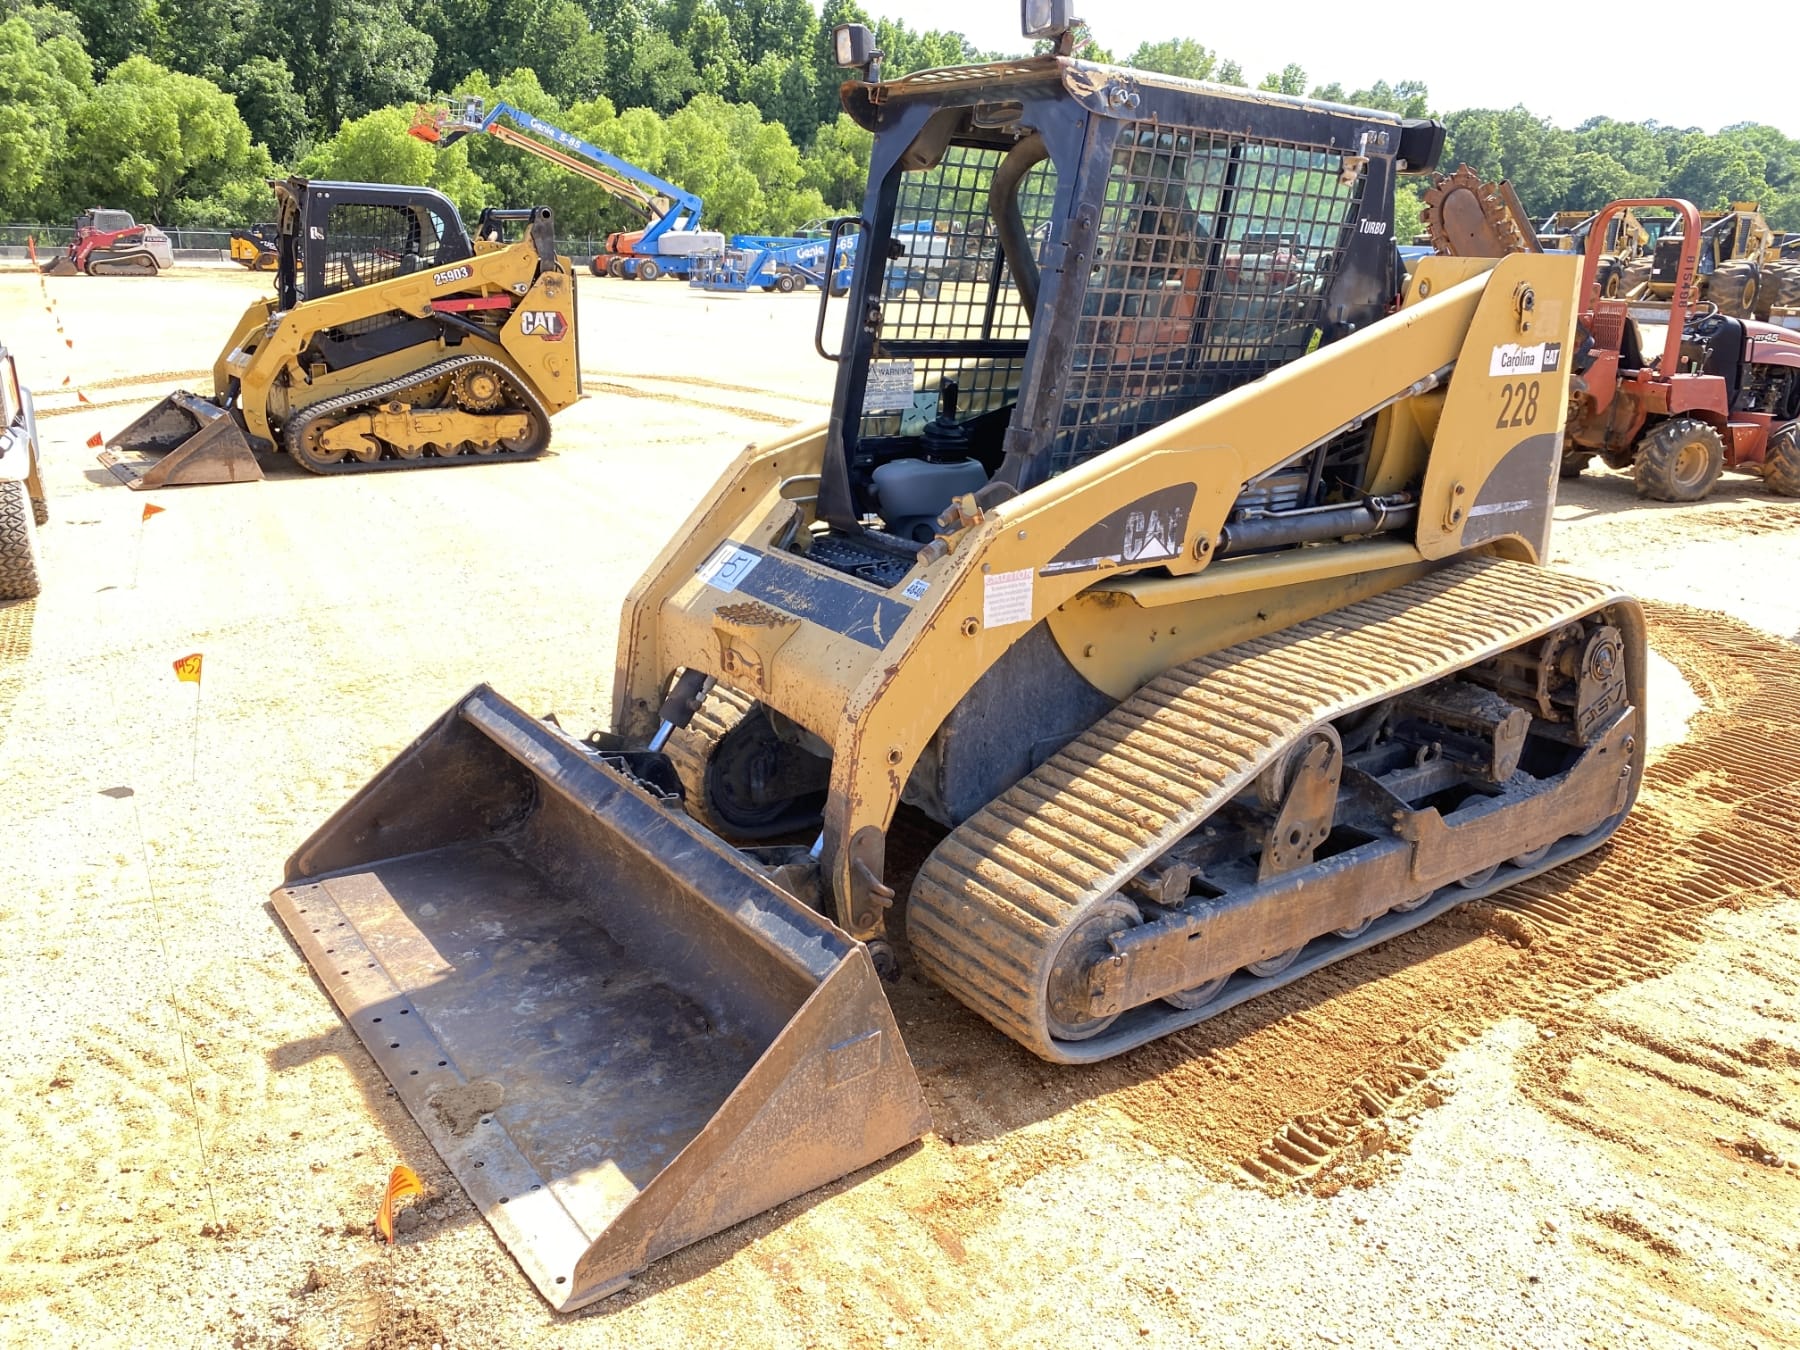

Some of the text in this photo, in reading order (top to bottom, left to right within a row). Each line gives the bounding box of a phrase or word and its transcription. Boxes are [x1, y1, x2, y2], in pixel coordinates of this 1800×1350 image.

[530, 118, 582, 149] Genie S-85
[1360, 218, 1387, 235] TURBO
[796, 237, 854, 259] Genie -65
[433, 267, 470, 286] 259D3
[521, 311, 557, 335] CAT
[1501, 352, 1536, 368] Carolina
[879, 367, 913, 377] WARNING
[1495, 380, 1540, 430] 228
